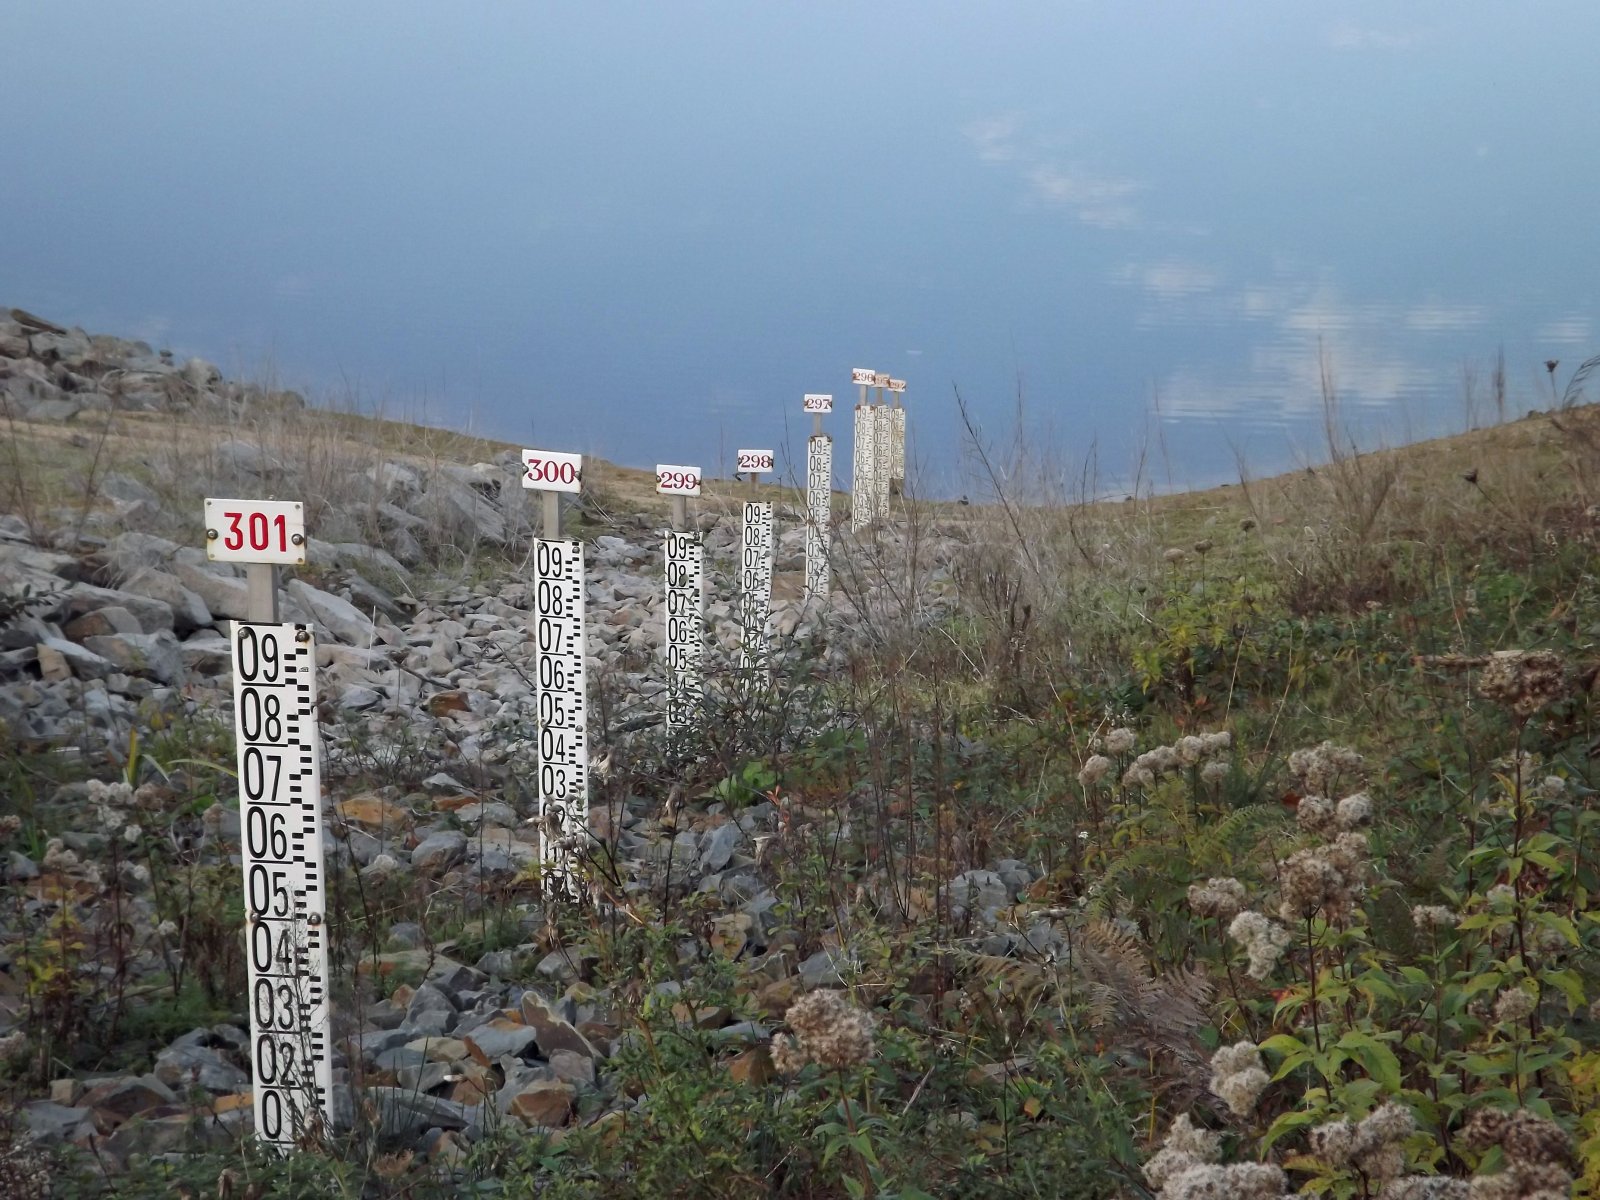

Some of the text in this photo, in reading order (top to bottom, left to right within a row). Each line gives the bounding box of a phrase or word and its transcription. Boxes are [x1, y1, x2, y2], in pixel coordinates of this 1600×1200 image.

[806, 398, 831, 410] 297
[856, 421, 866, 434] 08
[809, 438, 823, 454] 09
[855, 435, 865, 449] 07
[527, 458, 575, 485] 300
[741, 454, 771, 469] 298
[809, 455, 822, 472] 08
[660, 471, 697, 490] 299
[809, 472, 822, 489] 07
[808, 490, 821, 506] 06
[745, 503, 760, 524] 09
[224, 512, 287, 552] 301
[744, 525, 760, 546] 08
[537, 542, 562, 577] 09
[668, 533, 687, 560] 09
[744, 547, 759, 568] 07
[807, 542, 820, 558] 03
[668, 561, 687, 588] 08
[744, 569, 759, 590] 06
[538, 580, 563, 616] 08
[668, 589, 686, 615] 07
[539, 618, 563, 653] 07
[668, 617, 687, 642] 06
[238, 627, 279, 683] 09
[668, 645, 687, 670] 05
[540, 655, 564, 689] 06
[240, 687, 282, 743] 08
[540, 692, 565, 726] 05
[541, 728, 566, 762] 04
[243, 747, 282, 801] 07
[542, 764, 566, 798] 03
[247, 806, 287, 860] 06
[249, 864, 289, 917] 05
[252, 921, 292, 973] 04
[254, 978, 294, 1030] 03
[257, 1034, 296, 1086] 02
